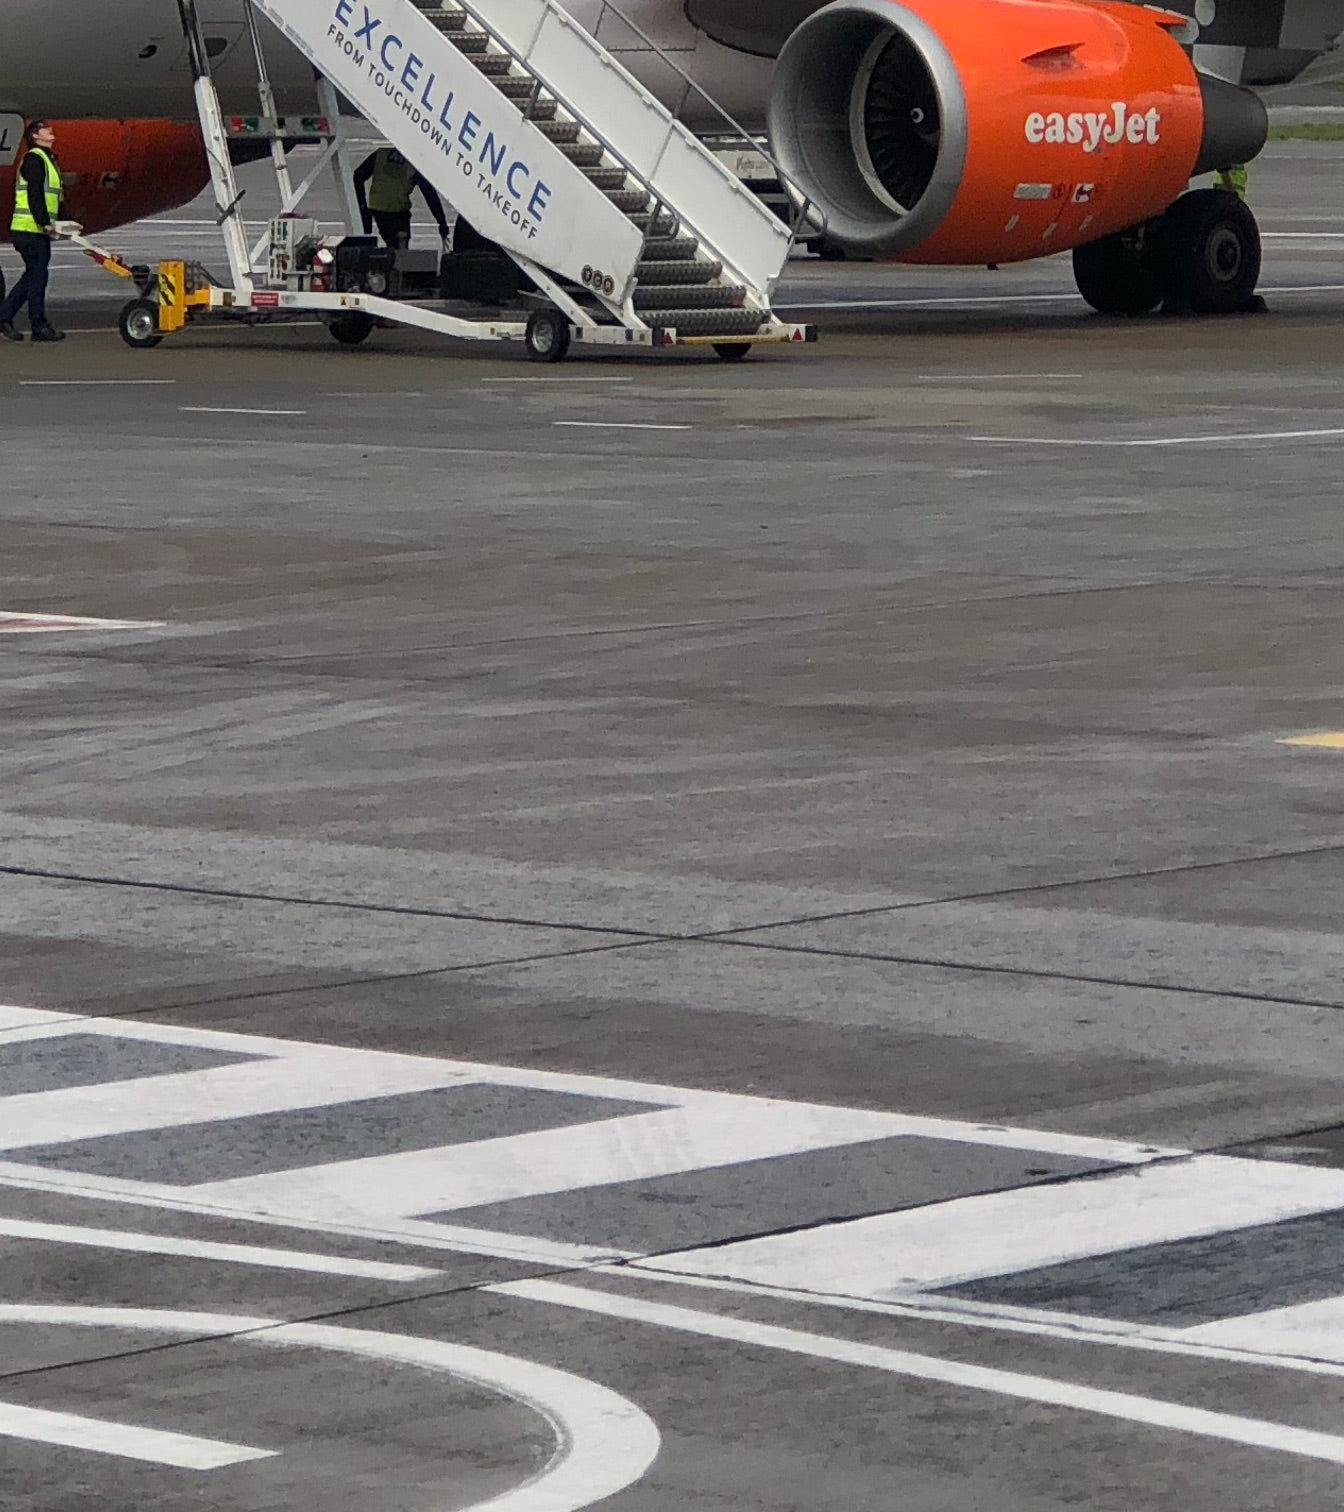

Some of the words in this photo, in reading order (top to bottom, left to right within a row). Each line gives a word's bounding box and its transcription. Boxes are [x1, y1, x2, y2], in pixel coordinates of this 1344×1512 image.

[327, 24, 365, 67] FROM
[368, 63, 452, 156] TOUCHDOWN
[456, 152, 473, 177] TO
[477, 173, 538, 239] TAKEOFF
[1024, 101, 1161, 153] easyJet
